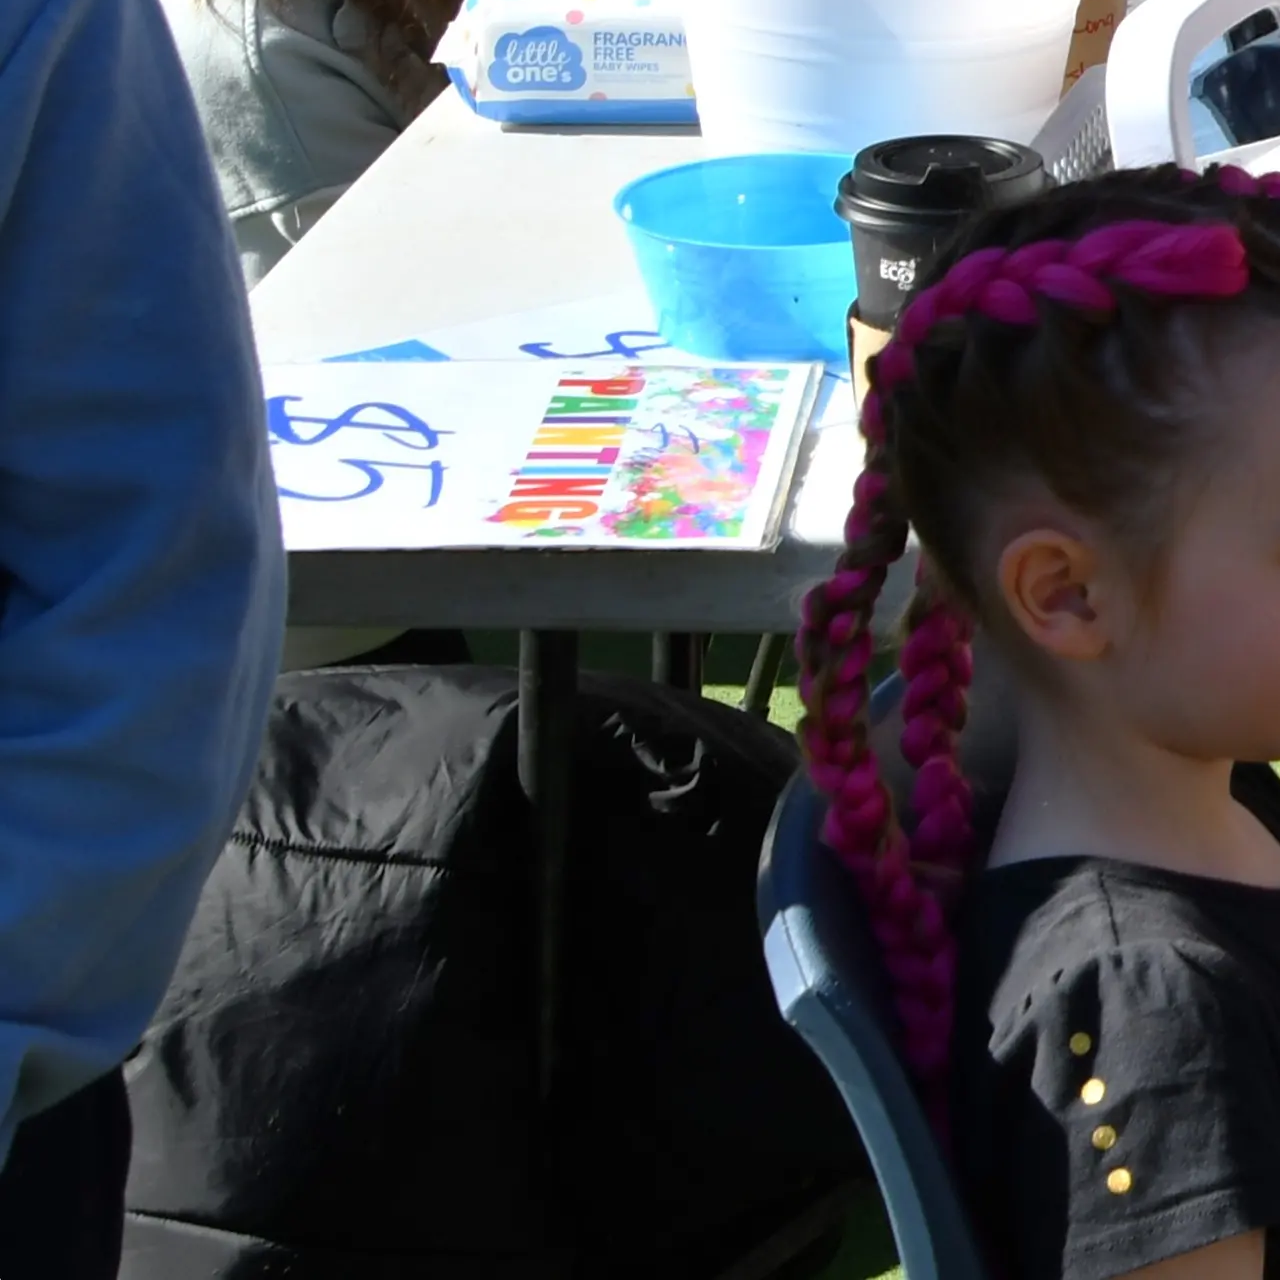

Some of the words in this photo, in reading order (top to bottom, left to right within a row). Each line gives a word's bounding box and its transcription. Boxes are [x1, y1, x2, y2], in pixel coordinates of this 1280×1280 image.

[593, 32, 688, 47] FRAGRAN
[505, 39, 572, 67] little
[593, 47, 635, 62] FREE
[506, 65, 573, 84] one's
[593, 62, 622, 72] BABY
[625, 63, 659, 72] WIPES
[266, 394, 456, 509] $5
[495, 378, 646, 526] PAINTING
